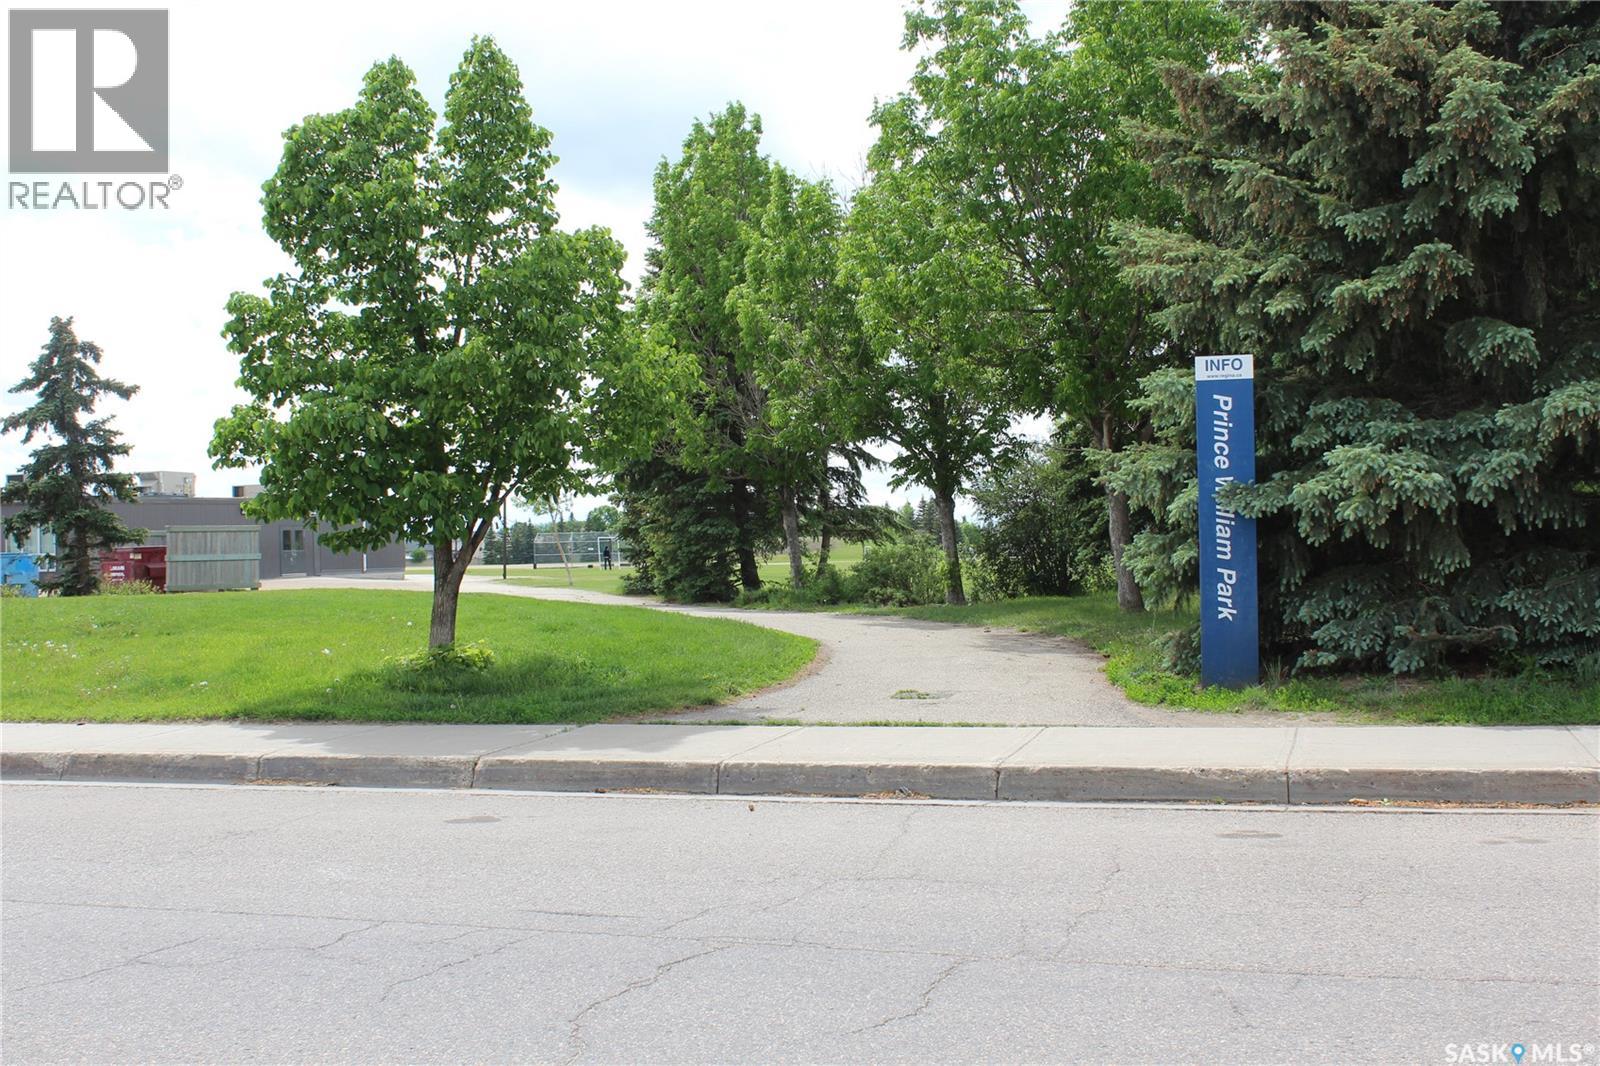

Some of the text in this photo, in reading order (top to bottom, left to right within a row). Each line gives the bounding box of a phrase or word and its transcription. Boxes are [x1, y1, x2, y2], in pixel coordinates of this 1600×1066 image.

[1205, 358, 1243, 371] INFO
[1213, 394, 1237, 621] Prince Wlliam Park
